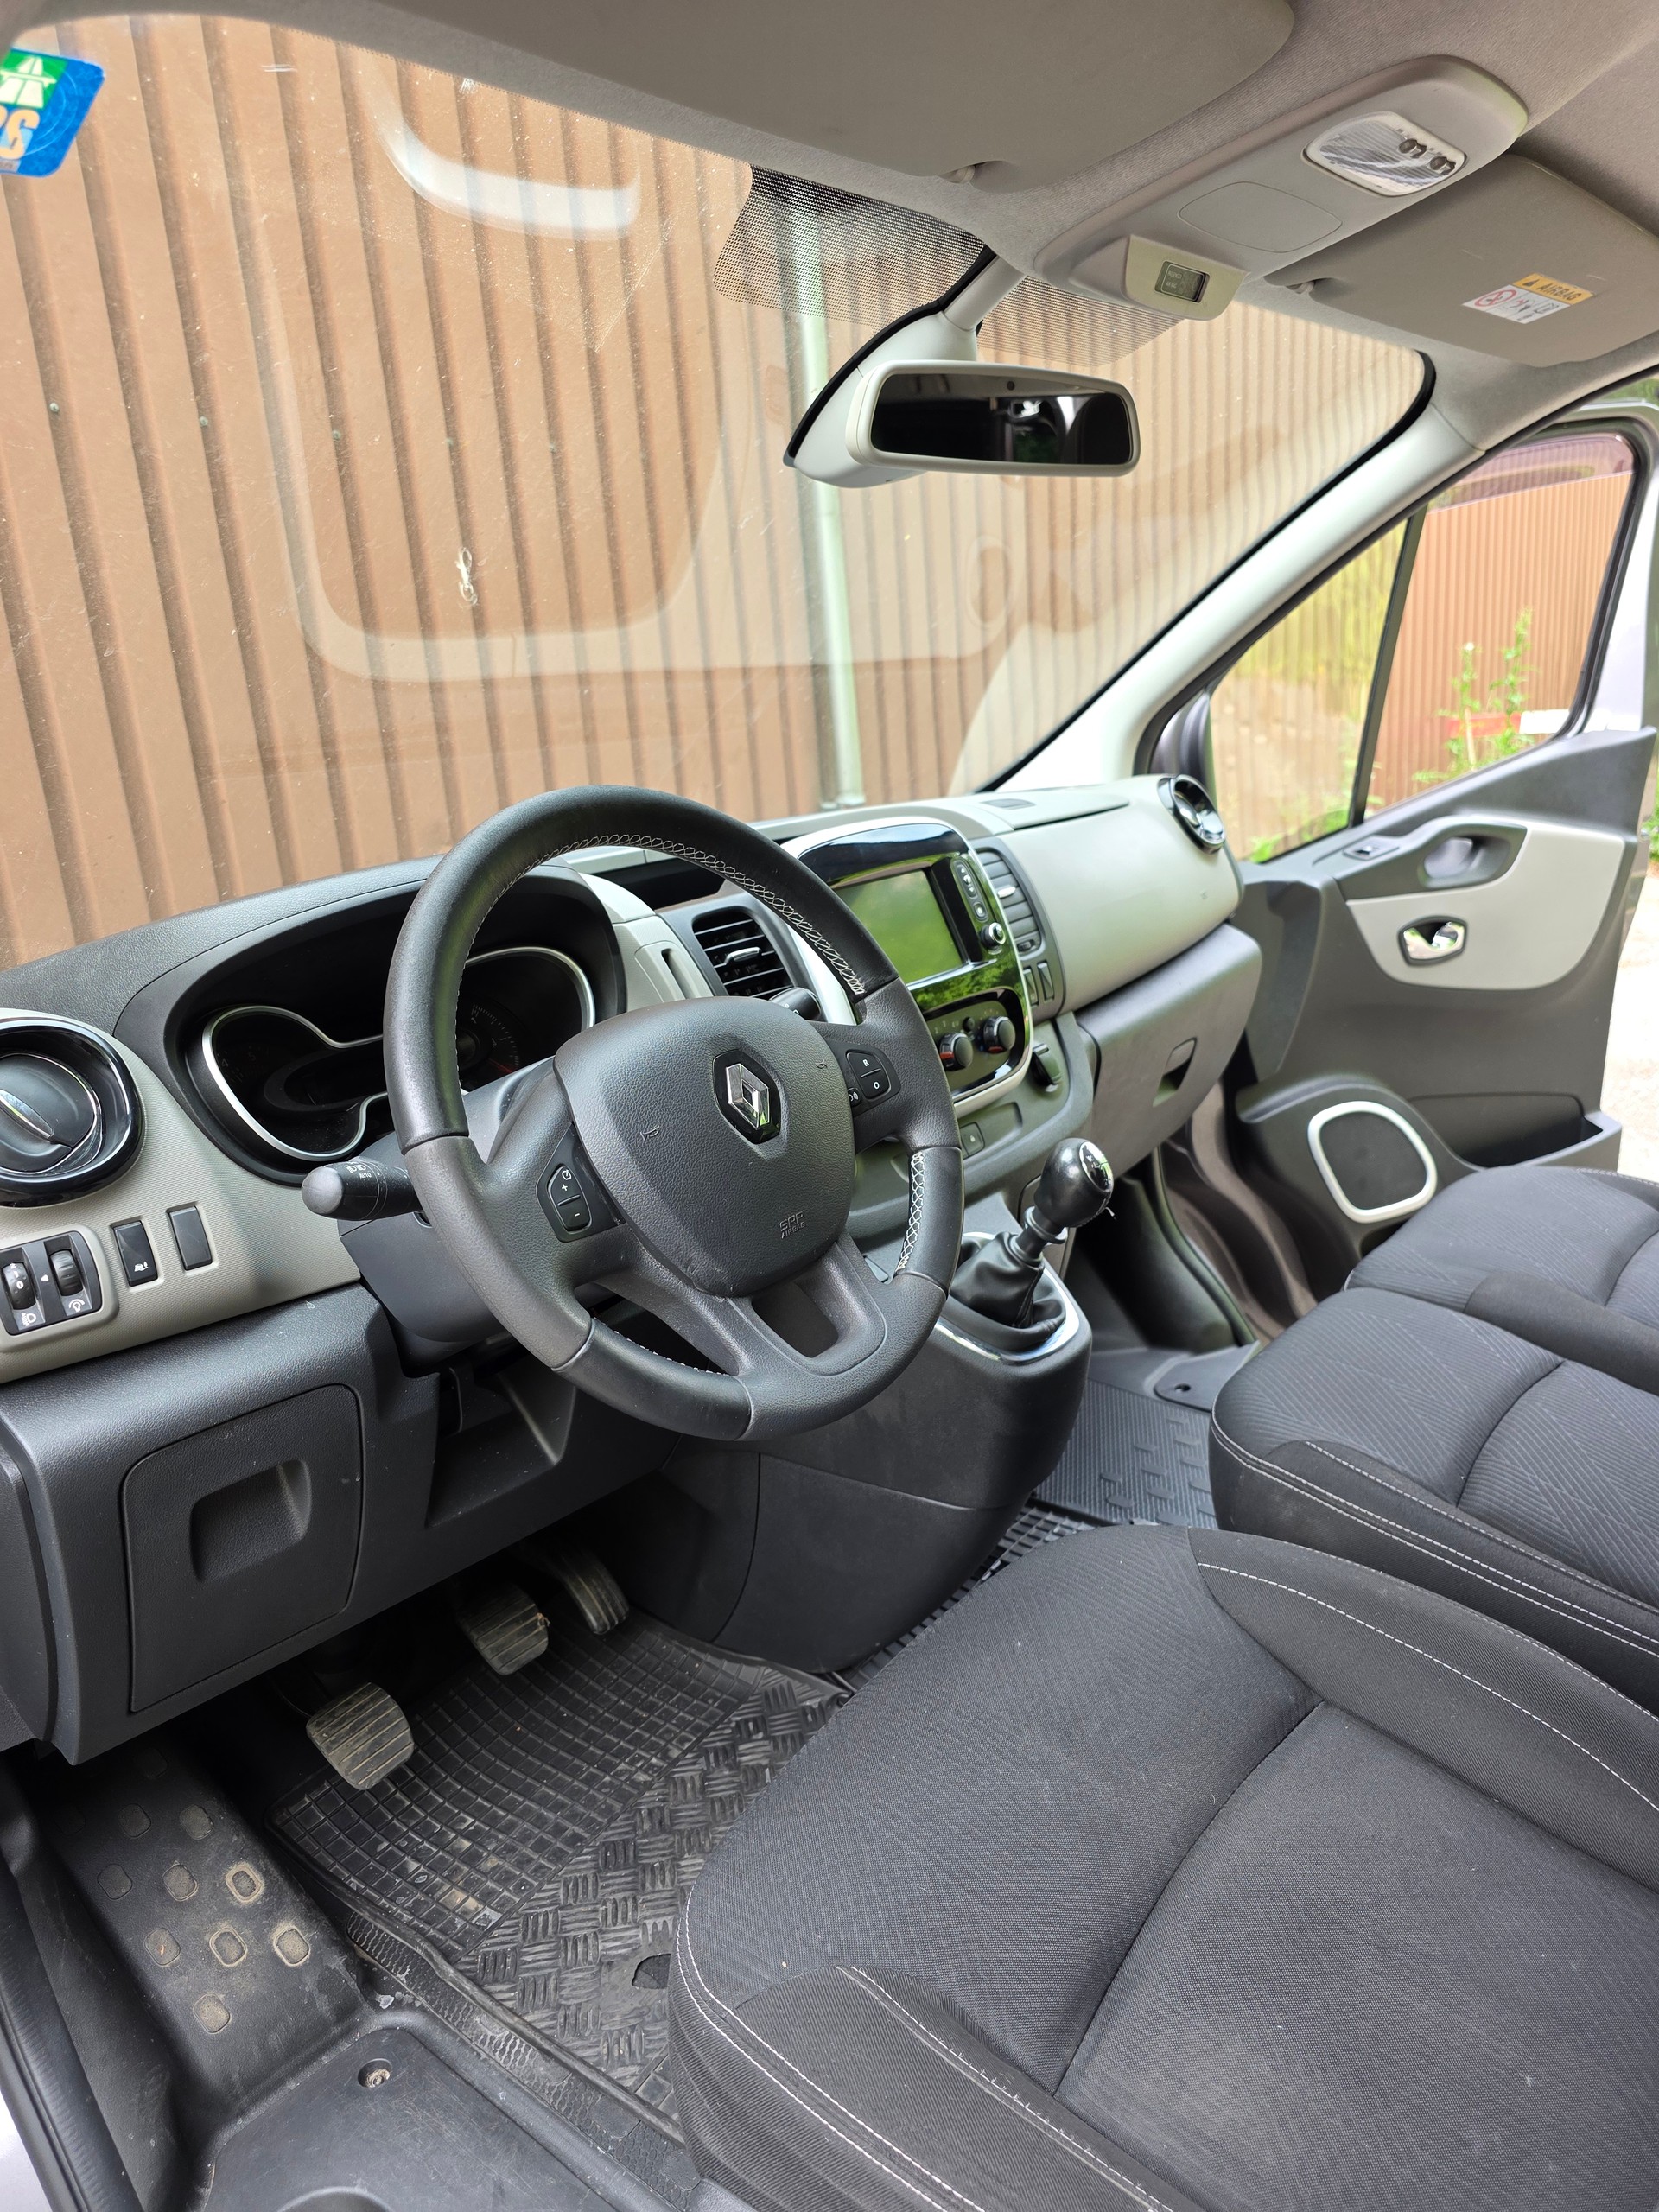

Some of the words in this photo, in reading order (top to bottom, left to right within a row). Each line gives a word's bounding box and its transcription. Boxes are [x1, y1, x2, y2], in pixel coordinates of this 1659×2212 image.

[0, 105, 40, 159] S
[1537, 283, 1582, 301] AIRBAG
[221, 1058, 229, 1067] 4
[781, 1221, 806, 1239] AIRBAG
